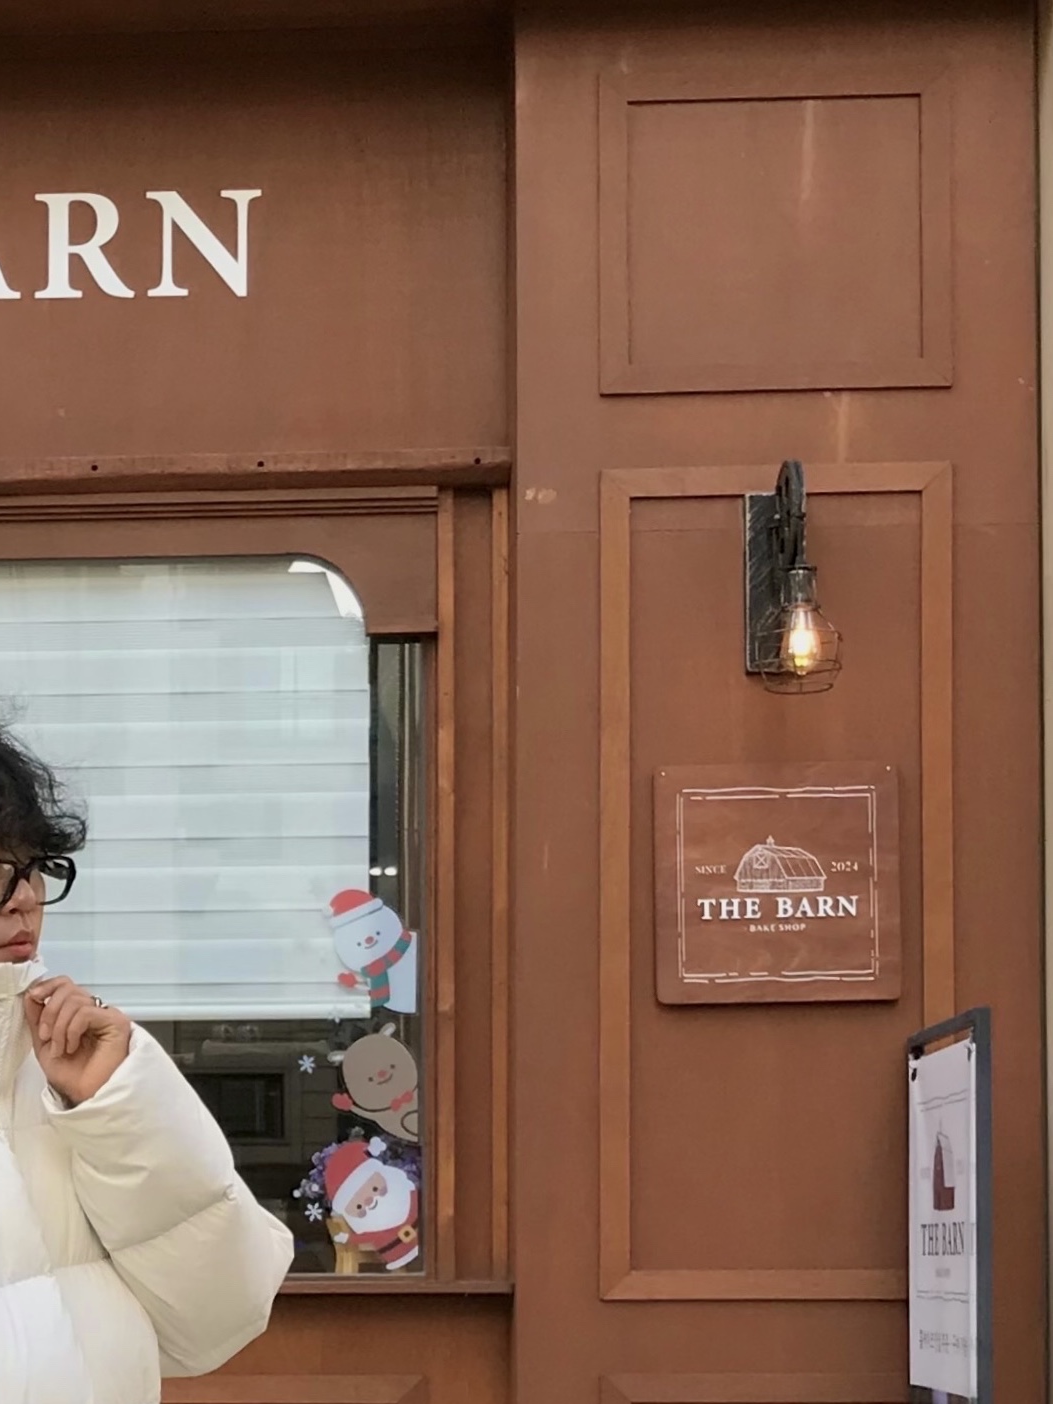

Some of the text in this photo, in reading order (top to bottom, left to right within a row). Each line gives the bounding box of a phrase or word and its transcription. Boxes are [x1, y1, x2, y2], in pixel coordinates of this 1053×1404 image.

[695, 861, 859, 875] SINCE 2024
[697, 896, 858, 920] THE BARN
[749, 922, 807, 933] BAKE SHOP
[920, 1223, 940, 1256] THE
